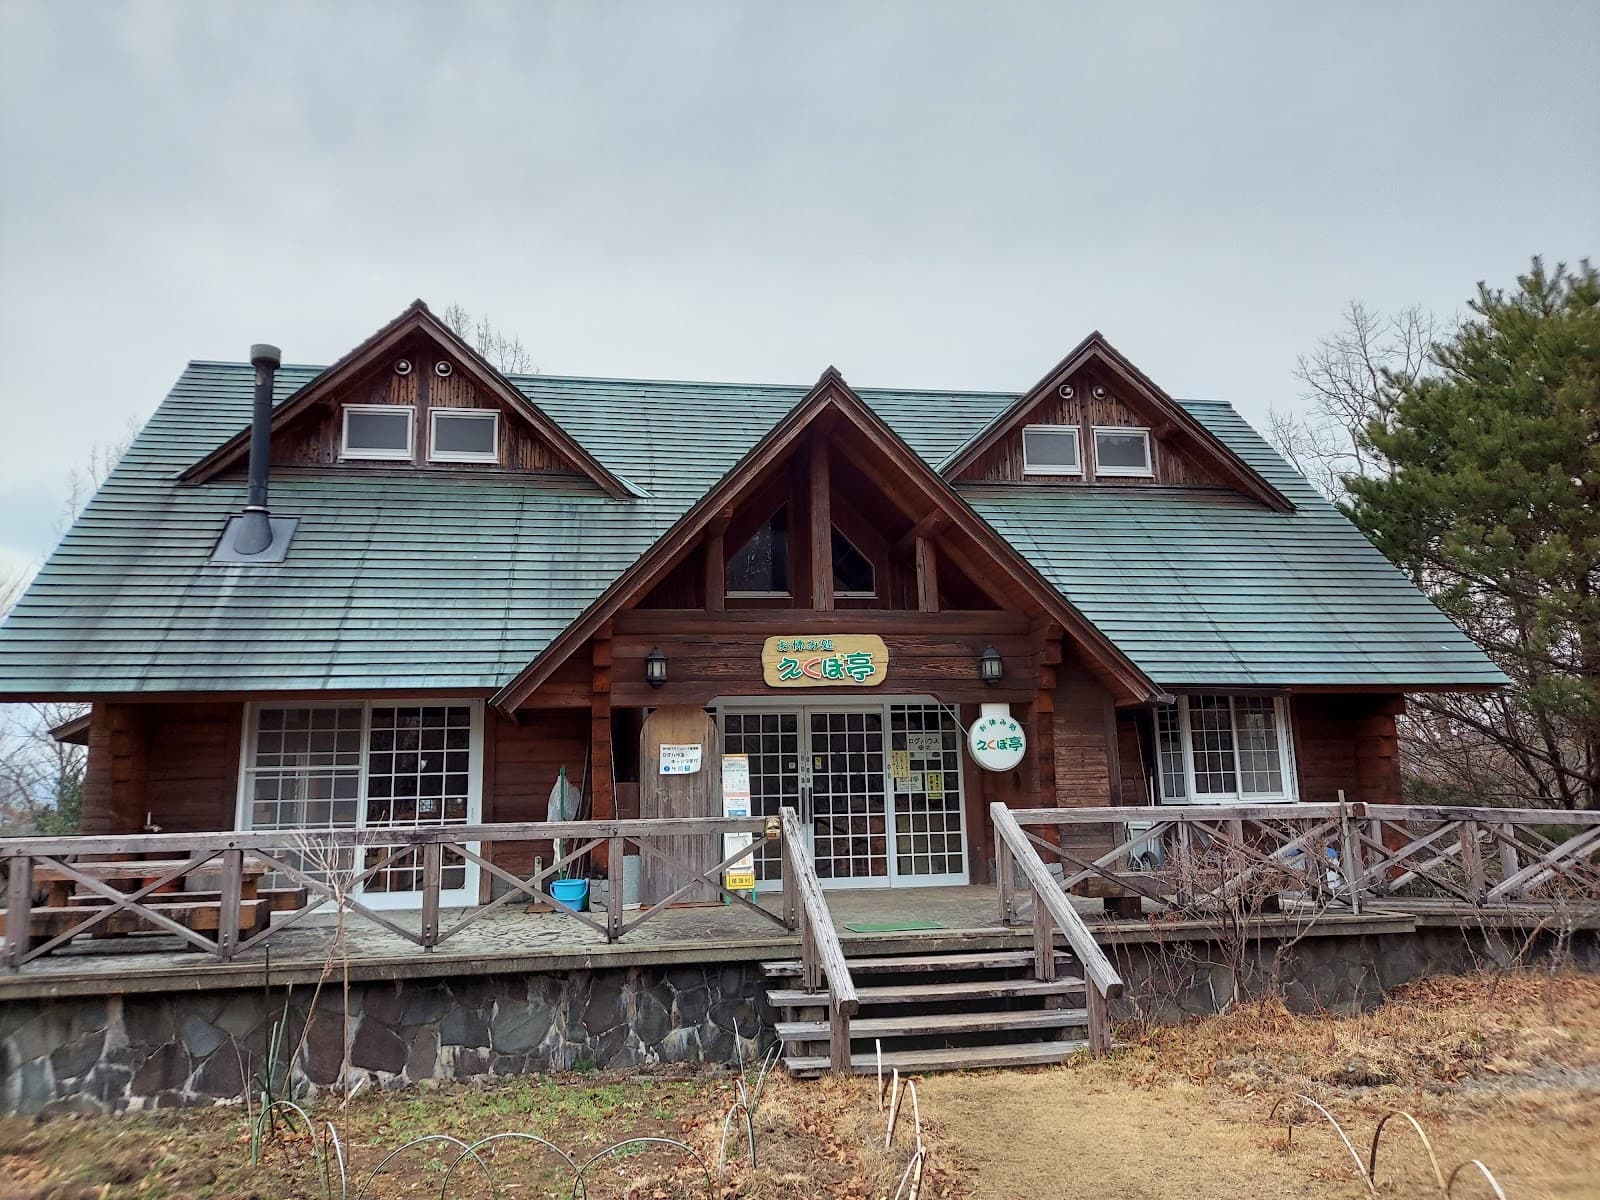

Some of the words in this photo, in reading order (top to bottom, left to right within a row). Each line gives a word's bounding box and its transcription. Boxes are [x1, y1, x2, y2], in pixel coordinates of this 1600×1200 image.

[777, 639, 834, 652] お休み処
[777, 651, 875, 682] えくぼ亭
[908, 737, 938, 745] ログハウス
[977, 734, 1023, 752] えくぼ亭
